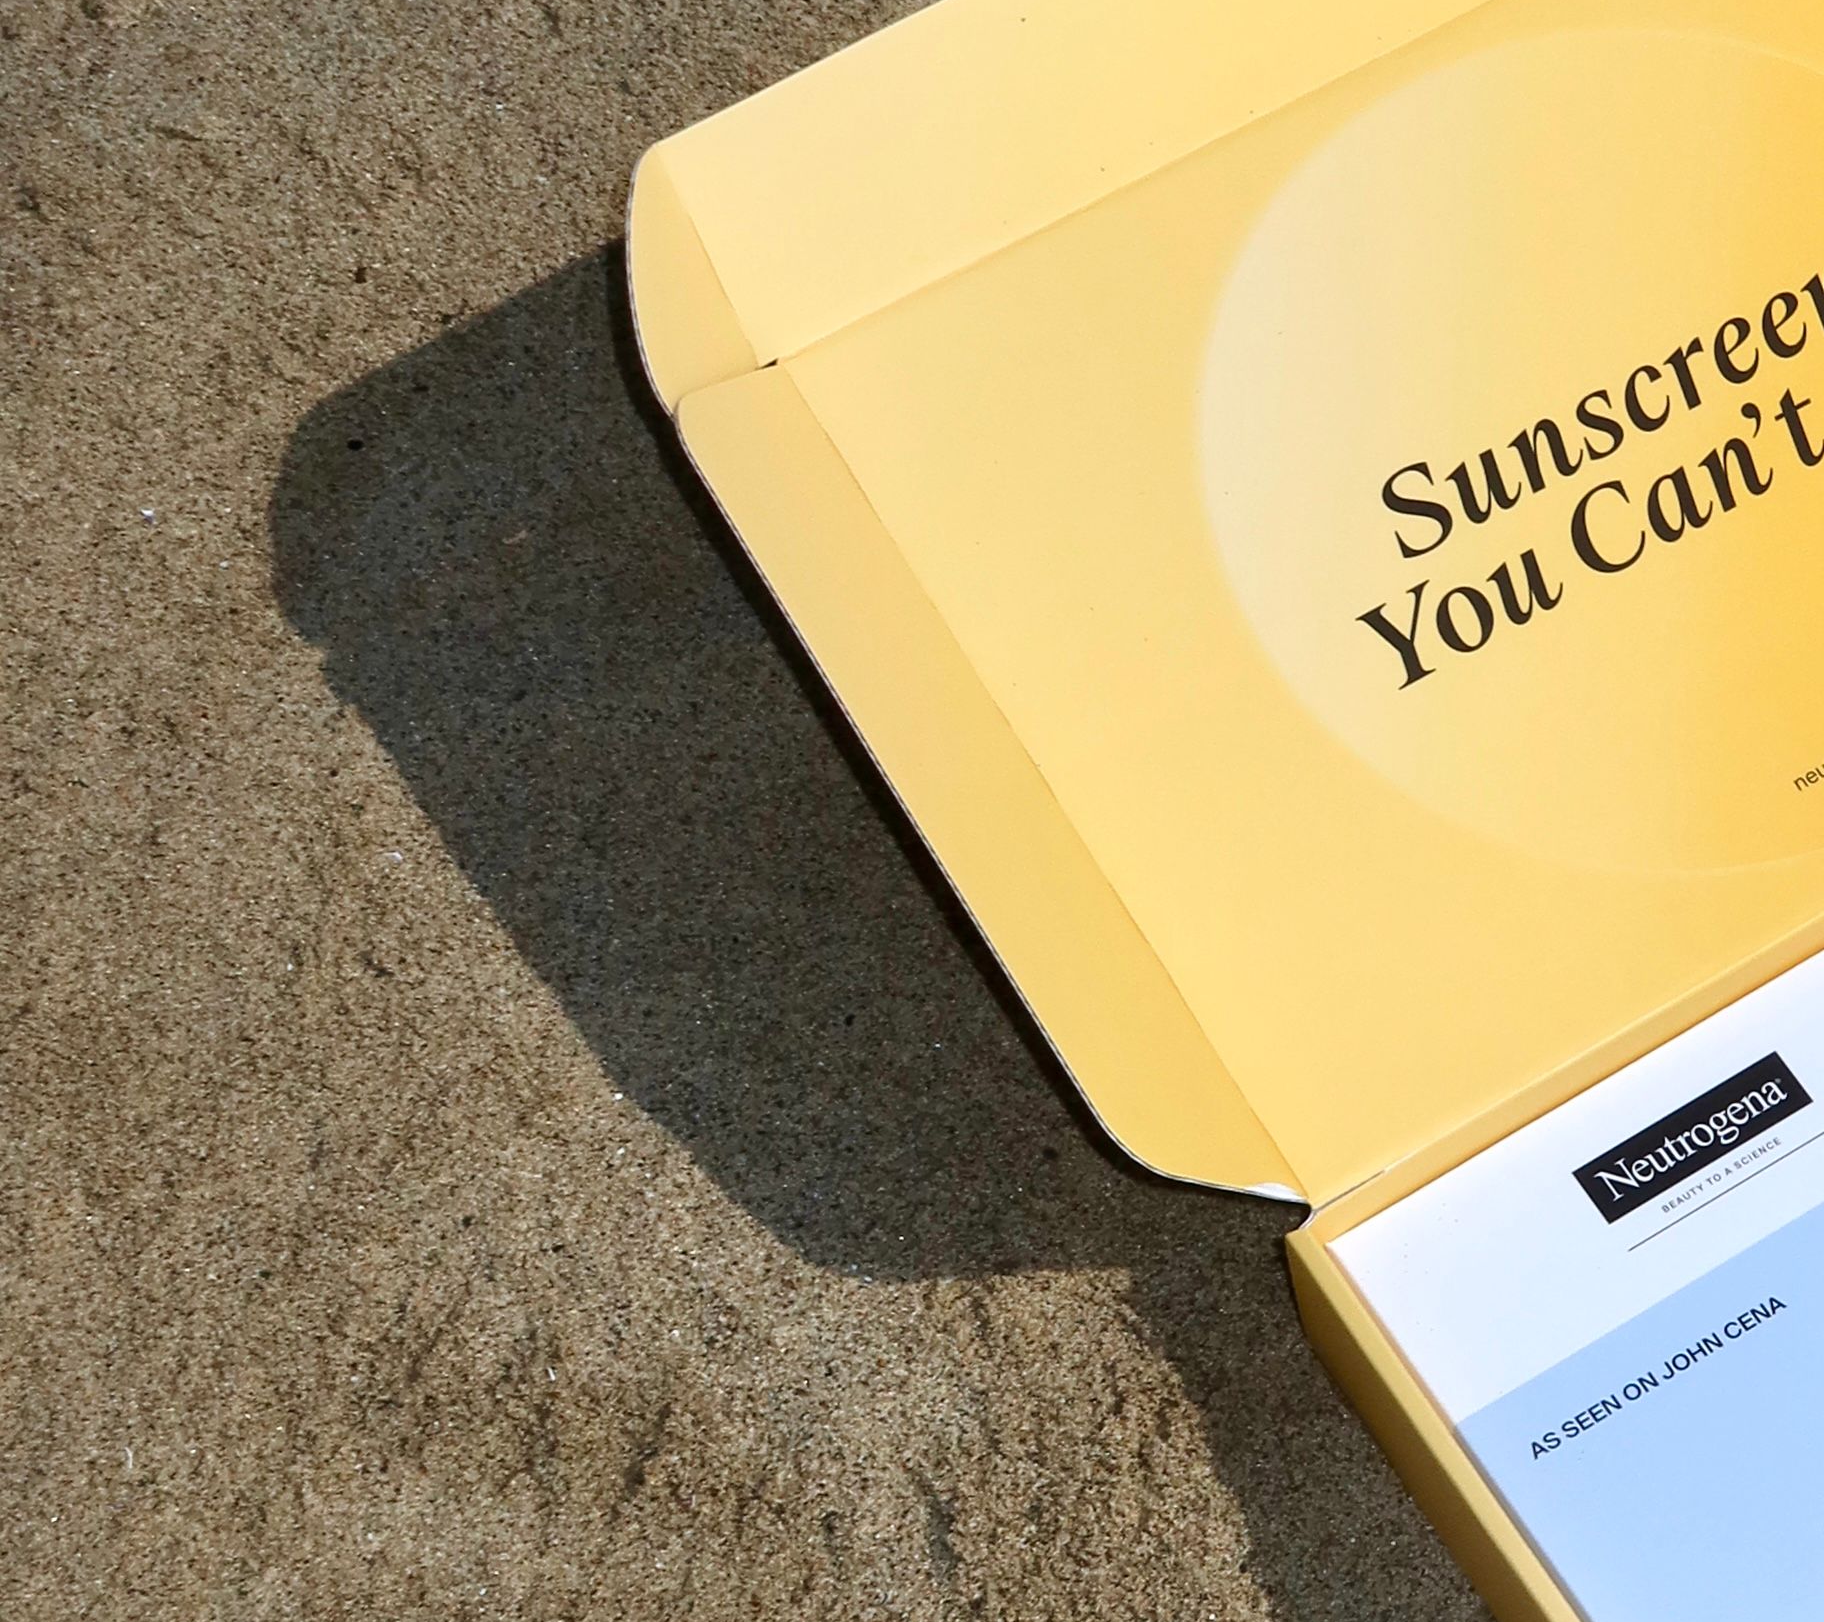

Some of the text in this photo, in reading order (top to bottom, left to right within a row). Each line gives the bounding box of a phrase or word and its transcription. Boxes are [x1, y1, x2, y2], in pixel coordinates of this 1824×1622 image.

[1355, 549, 1563, 690] You
[1594, 1078, 1787, 1202] Neutrogena
[1661, 1136, 1782, 1213] BEAUTY TO A SCIENCE
[1530, 1296, 1787, 1460] AS SEEN ON JOHN CENA
